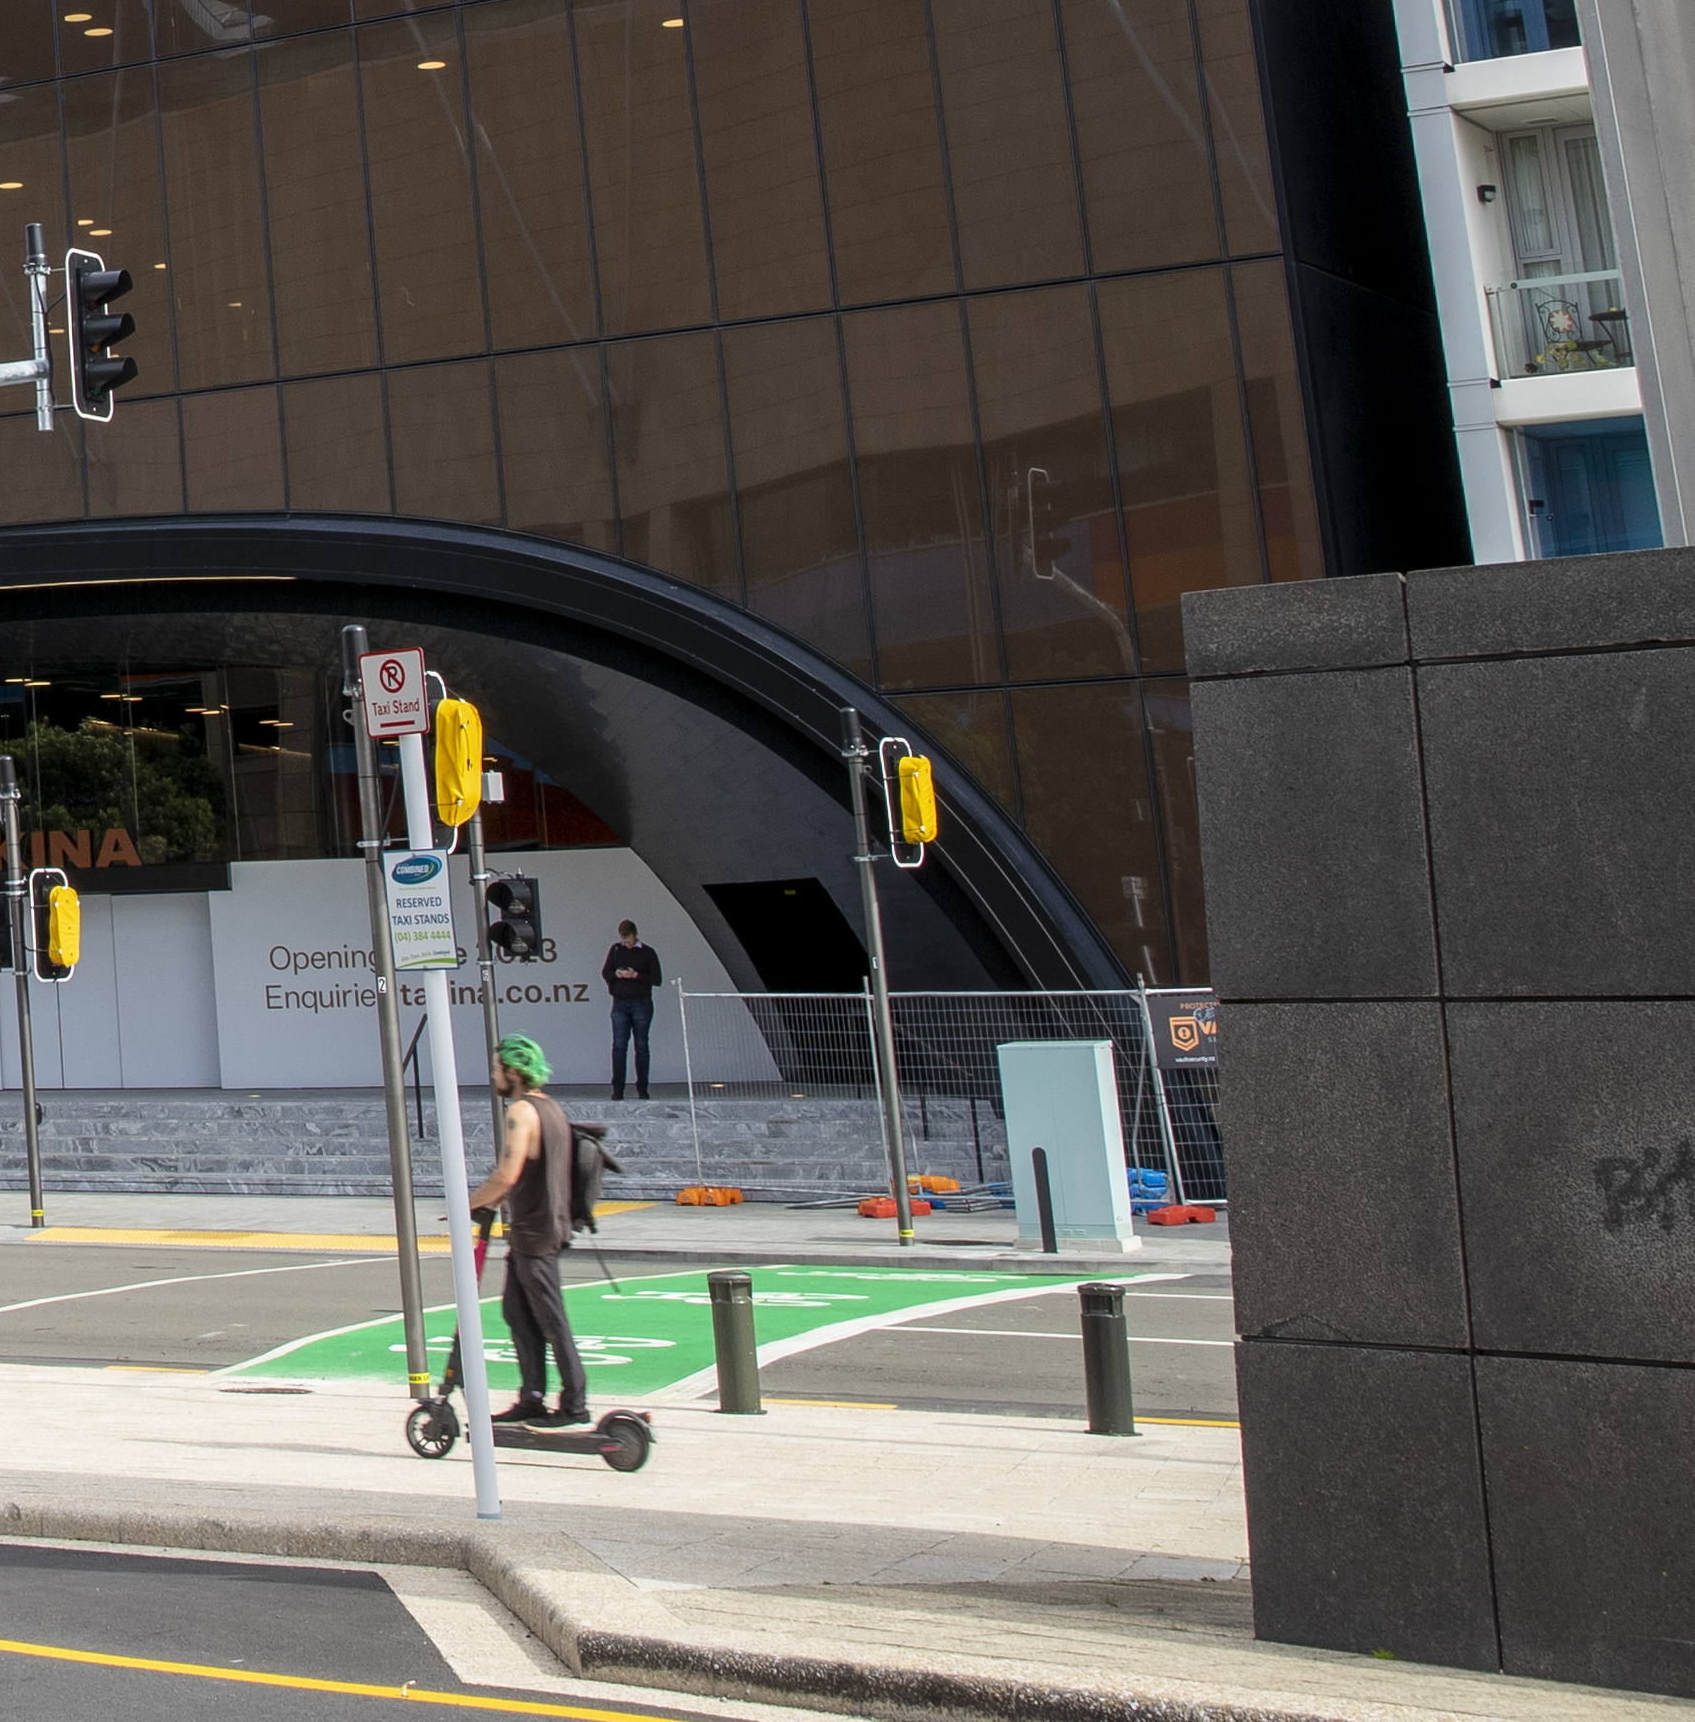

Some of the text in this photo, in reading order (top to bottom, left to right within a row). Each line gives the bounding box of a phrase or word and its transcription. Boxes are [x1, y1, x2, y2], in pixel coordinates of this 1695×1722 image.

[372, 698, 419, 716] Taxi Stand
[396, 896, 442, 909] RESERVED
[392, 913, 450, 926] TAXI STANDS
[395, 931, 411, 944] (04)
[413, 931, 429, 941] 384
[379, 979, 385, 992] 2
